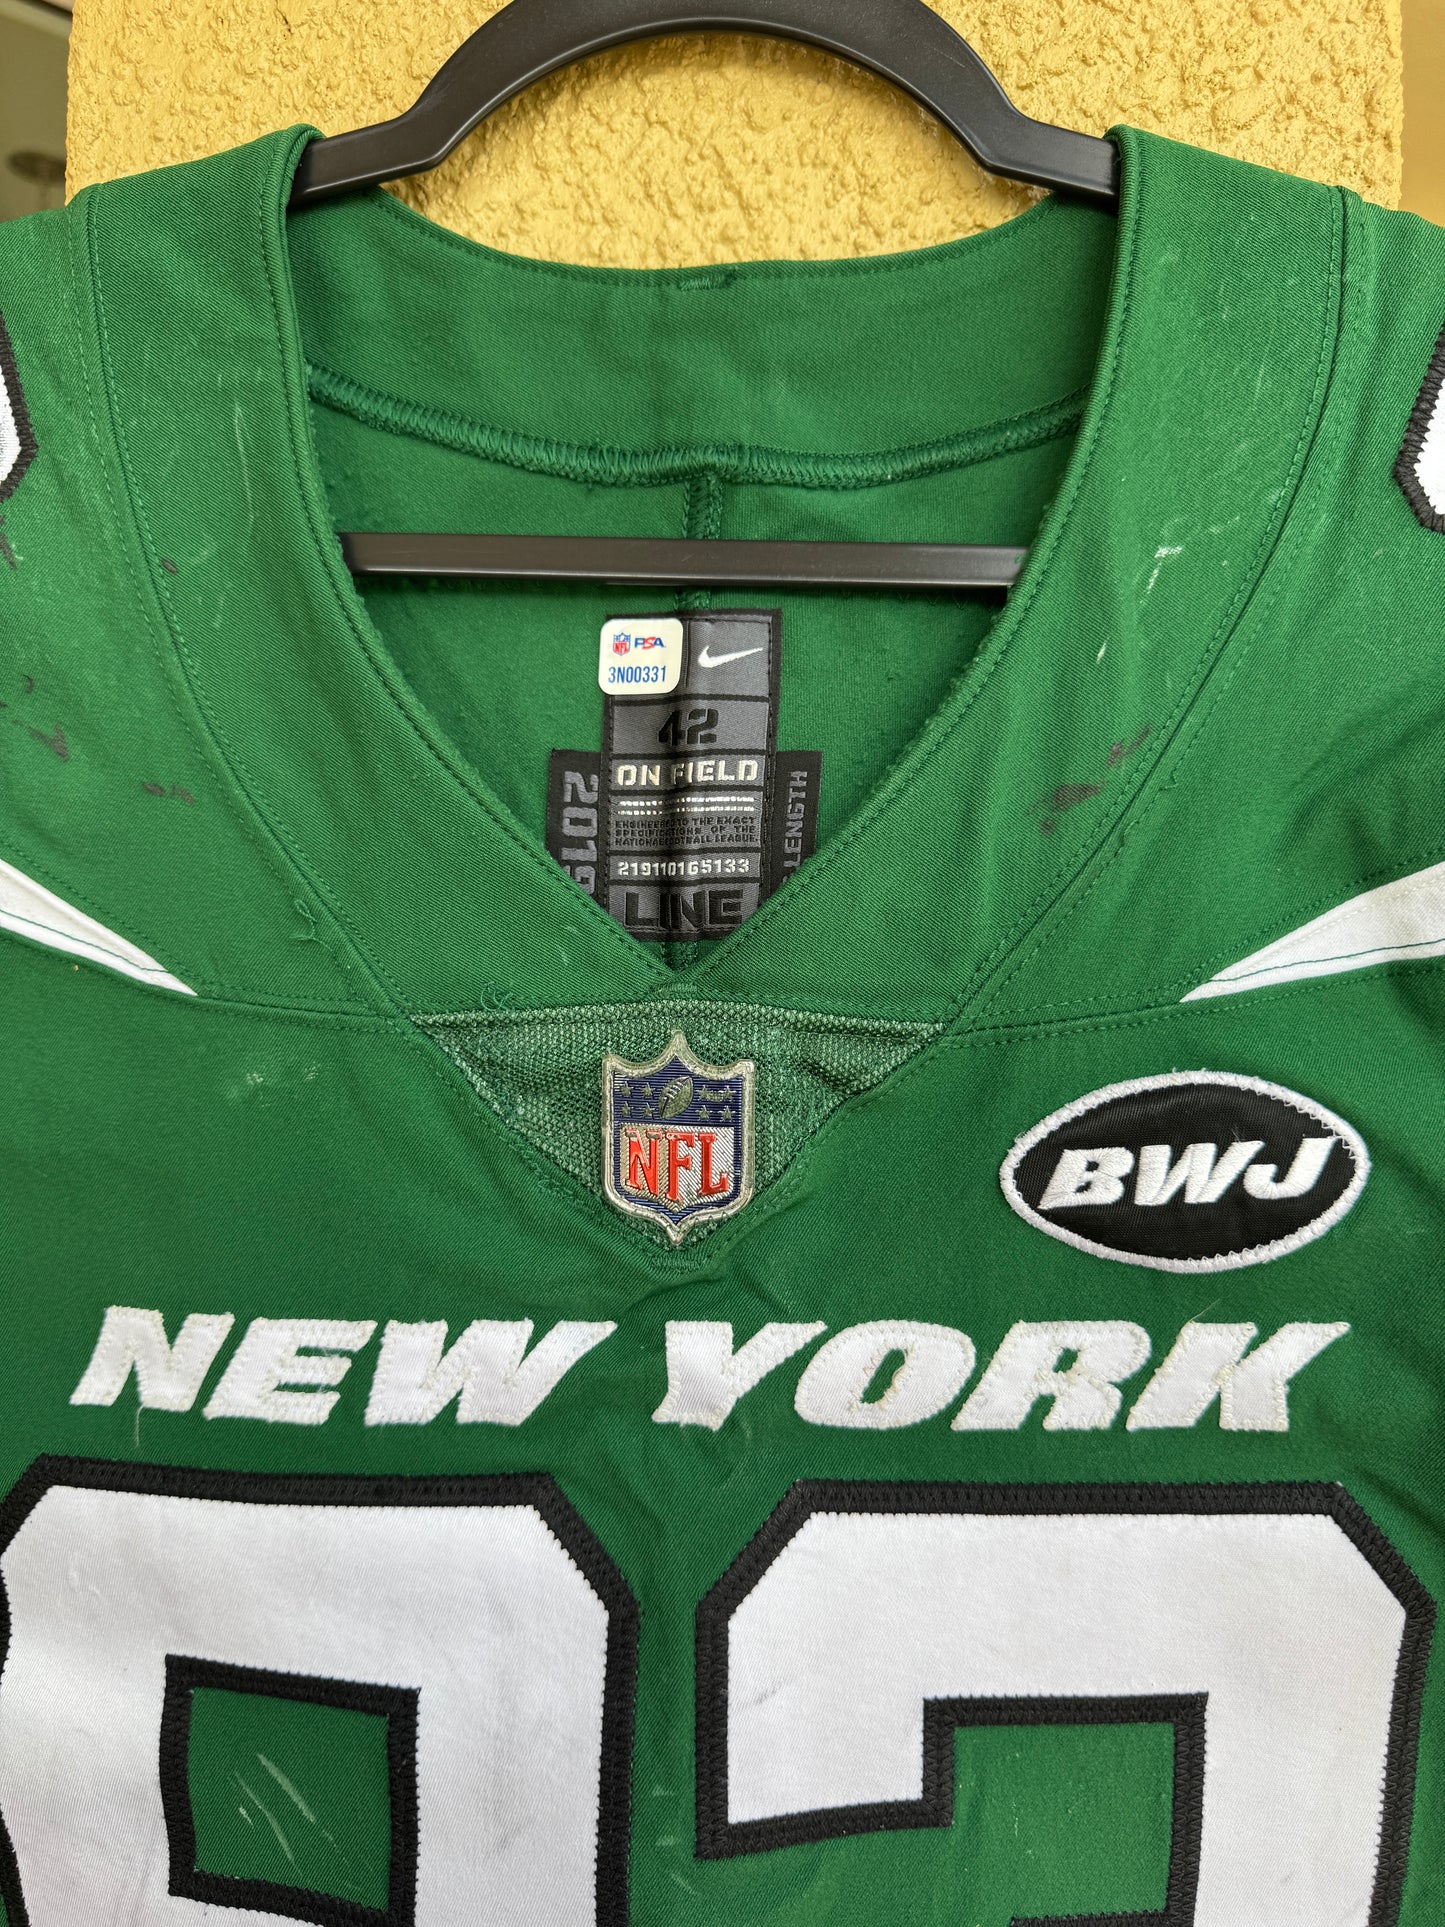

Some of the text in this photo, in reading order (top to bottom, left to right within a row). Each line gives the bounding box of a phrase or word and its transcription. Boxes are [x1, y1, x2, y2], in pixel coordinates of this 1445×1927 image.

[634, 636, 664, 650] PSA
[608, 666, 666, 683] 3N00331
[658, 708, 719, 746] 42
[617, 759, 758, 786] ON FIELD
[692, 815, 713, 826] THE
[717, 815, 756, 825] EXACT
[711, 825, 726, 834] OF
[734, 825, 755, 834] THE
[617, 858, 750, 877] 219110165133
[625, 890, 743, 930] LINE
[625, 1128, 729, 1203] NFL
[1037, 1136, 1339, 1210] BWJ
[69, 1304, 1351, 1432] NEW YORK
